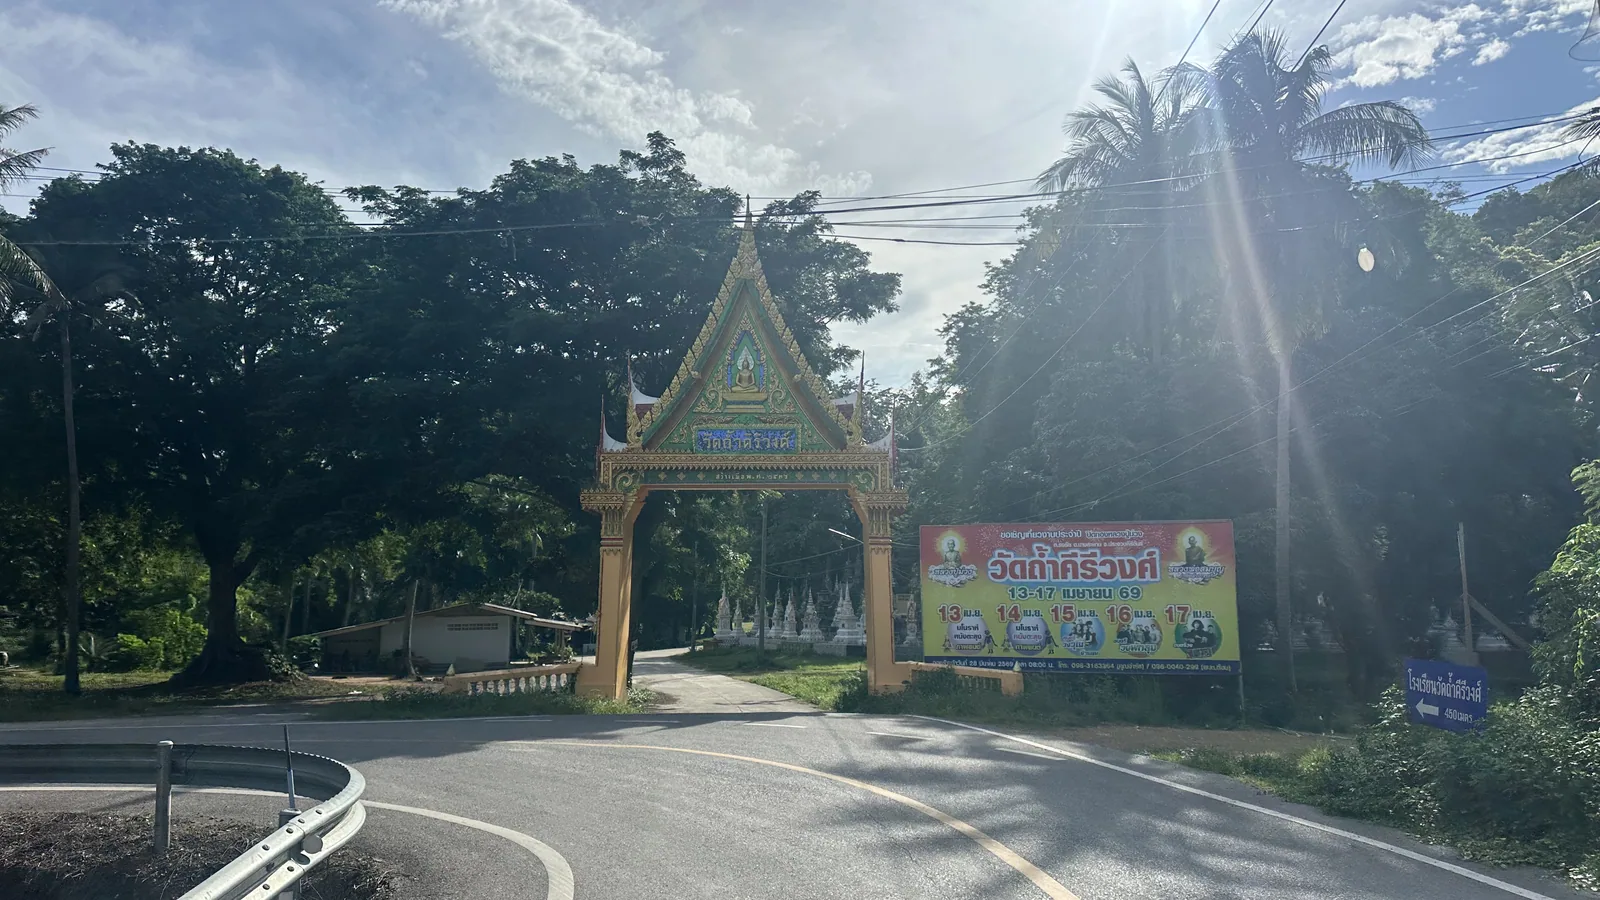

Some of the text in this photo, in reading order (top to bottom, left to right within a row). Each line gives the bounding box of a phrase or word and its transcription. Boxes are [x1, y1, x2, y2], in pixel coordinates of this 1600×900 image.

[990, 546, 1158, 580] วัดถ้ำคีรีวงศ์
[1008, 586, 1142, 600] 13-17 เมษายน 69
[938, 605, 983, 622] 13 เม.ย.
[997, 605, 1043, 622] 14 เม.ย.
[1051, 605, 1098, 622] 15 เม.ย.
[1107, 605, 1155, 622] 16 เม.ย.
[1165, 605, 1214, 622] 17 เม.ย.
[1407, 668, 1482, 703] โรงเรียนวัดถ้ำคีรีวงศ์
